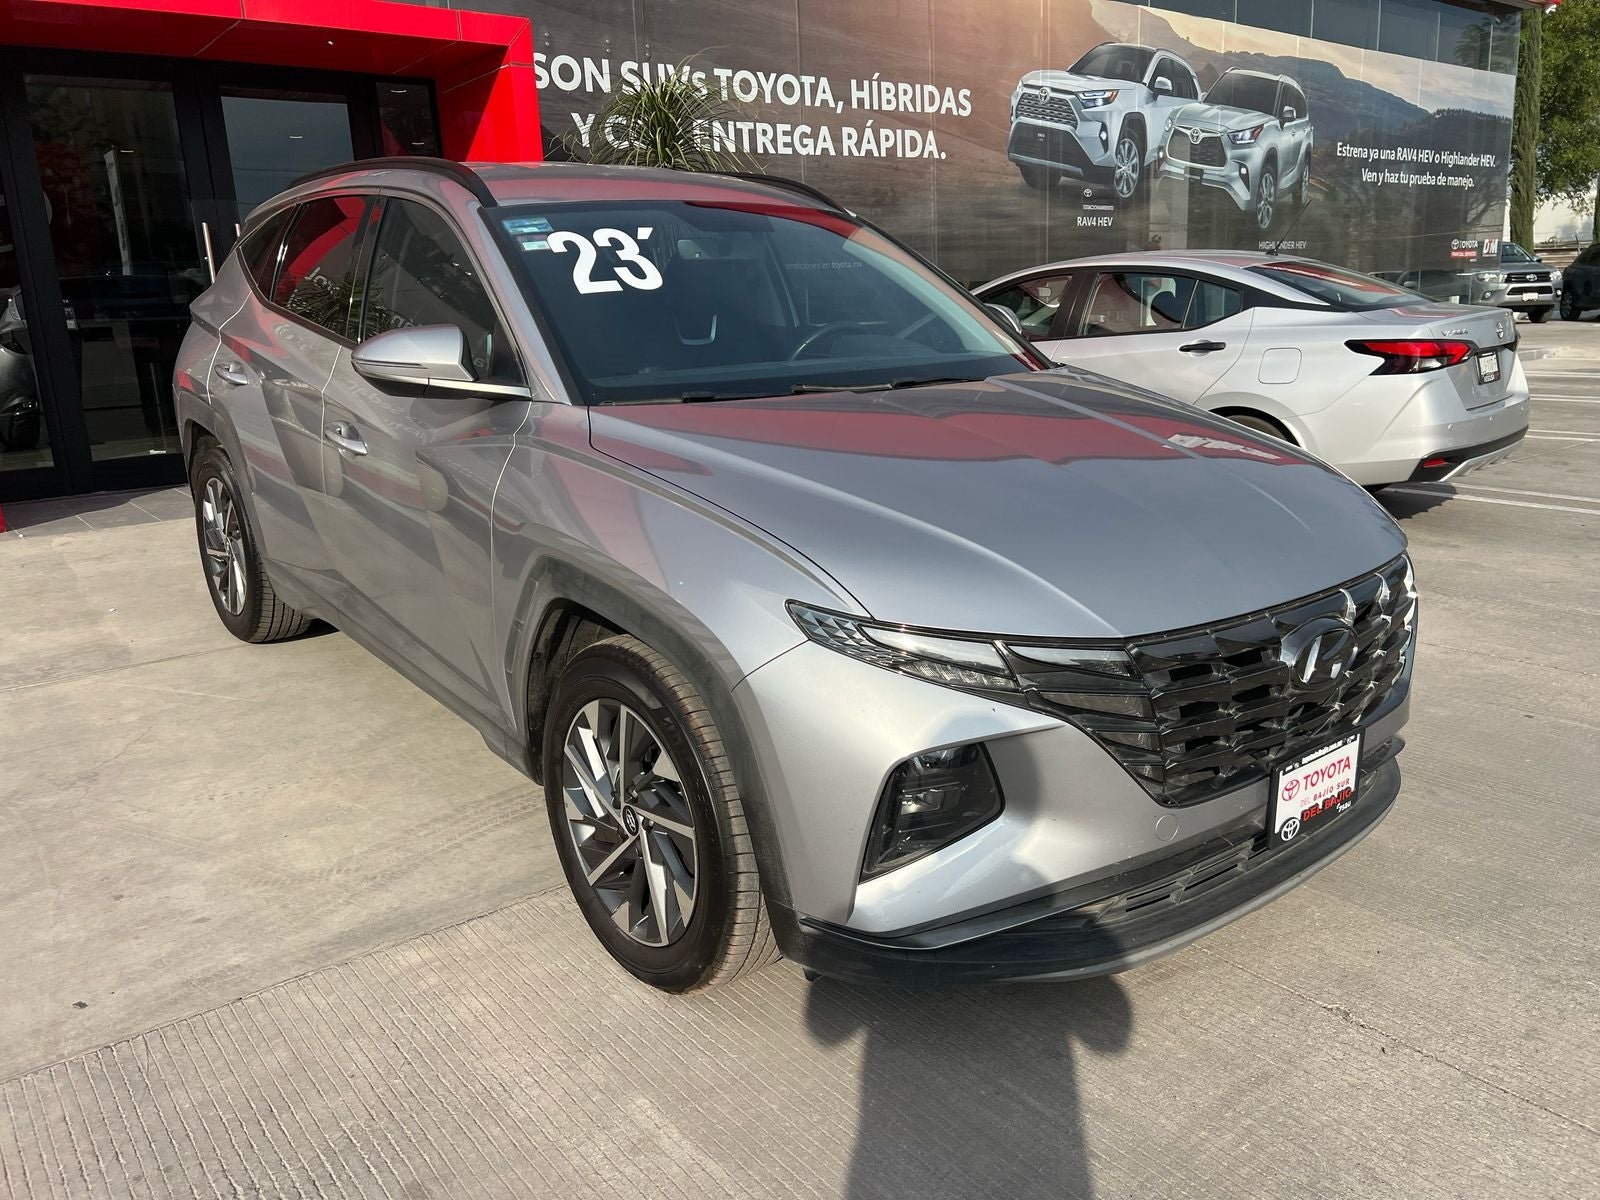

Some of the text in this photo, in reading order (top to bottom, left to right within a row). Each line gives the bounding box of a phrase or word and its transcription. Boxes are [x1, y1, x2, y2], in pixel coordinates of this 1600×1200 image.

[533, 52, 611, 93] SON
[713, 68, 844, 114] TOYOTA,
[851, 72, 972, 117] HÍBRIDAS
[571, 112, 596, 147] Y
[693, 119, 836, 156] ENTREGA
[842, 120, 946, 160] RÁPIDA.
[1337, 142, 1496, 168] Estrena ya una RAV4 HEV o Highlander HEV.
[1361, 168, 1475, 190] Ven y haz tu prueba de manejo.
[1077, 216, 1113, 227] RAV4 HEV
[1303, 756, 1351, 791] TOYOTA
[1336, 778, 1350, 790] SUR
[1303, 806, 1323, 822] DEL
